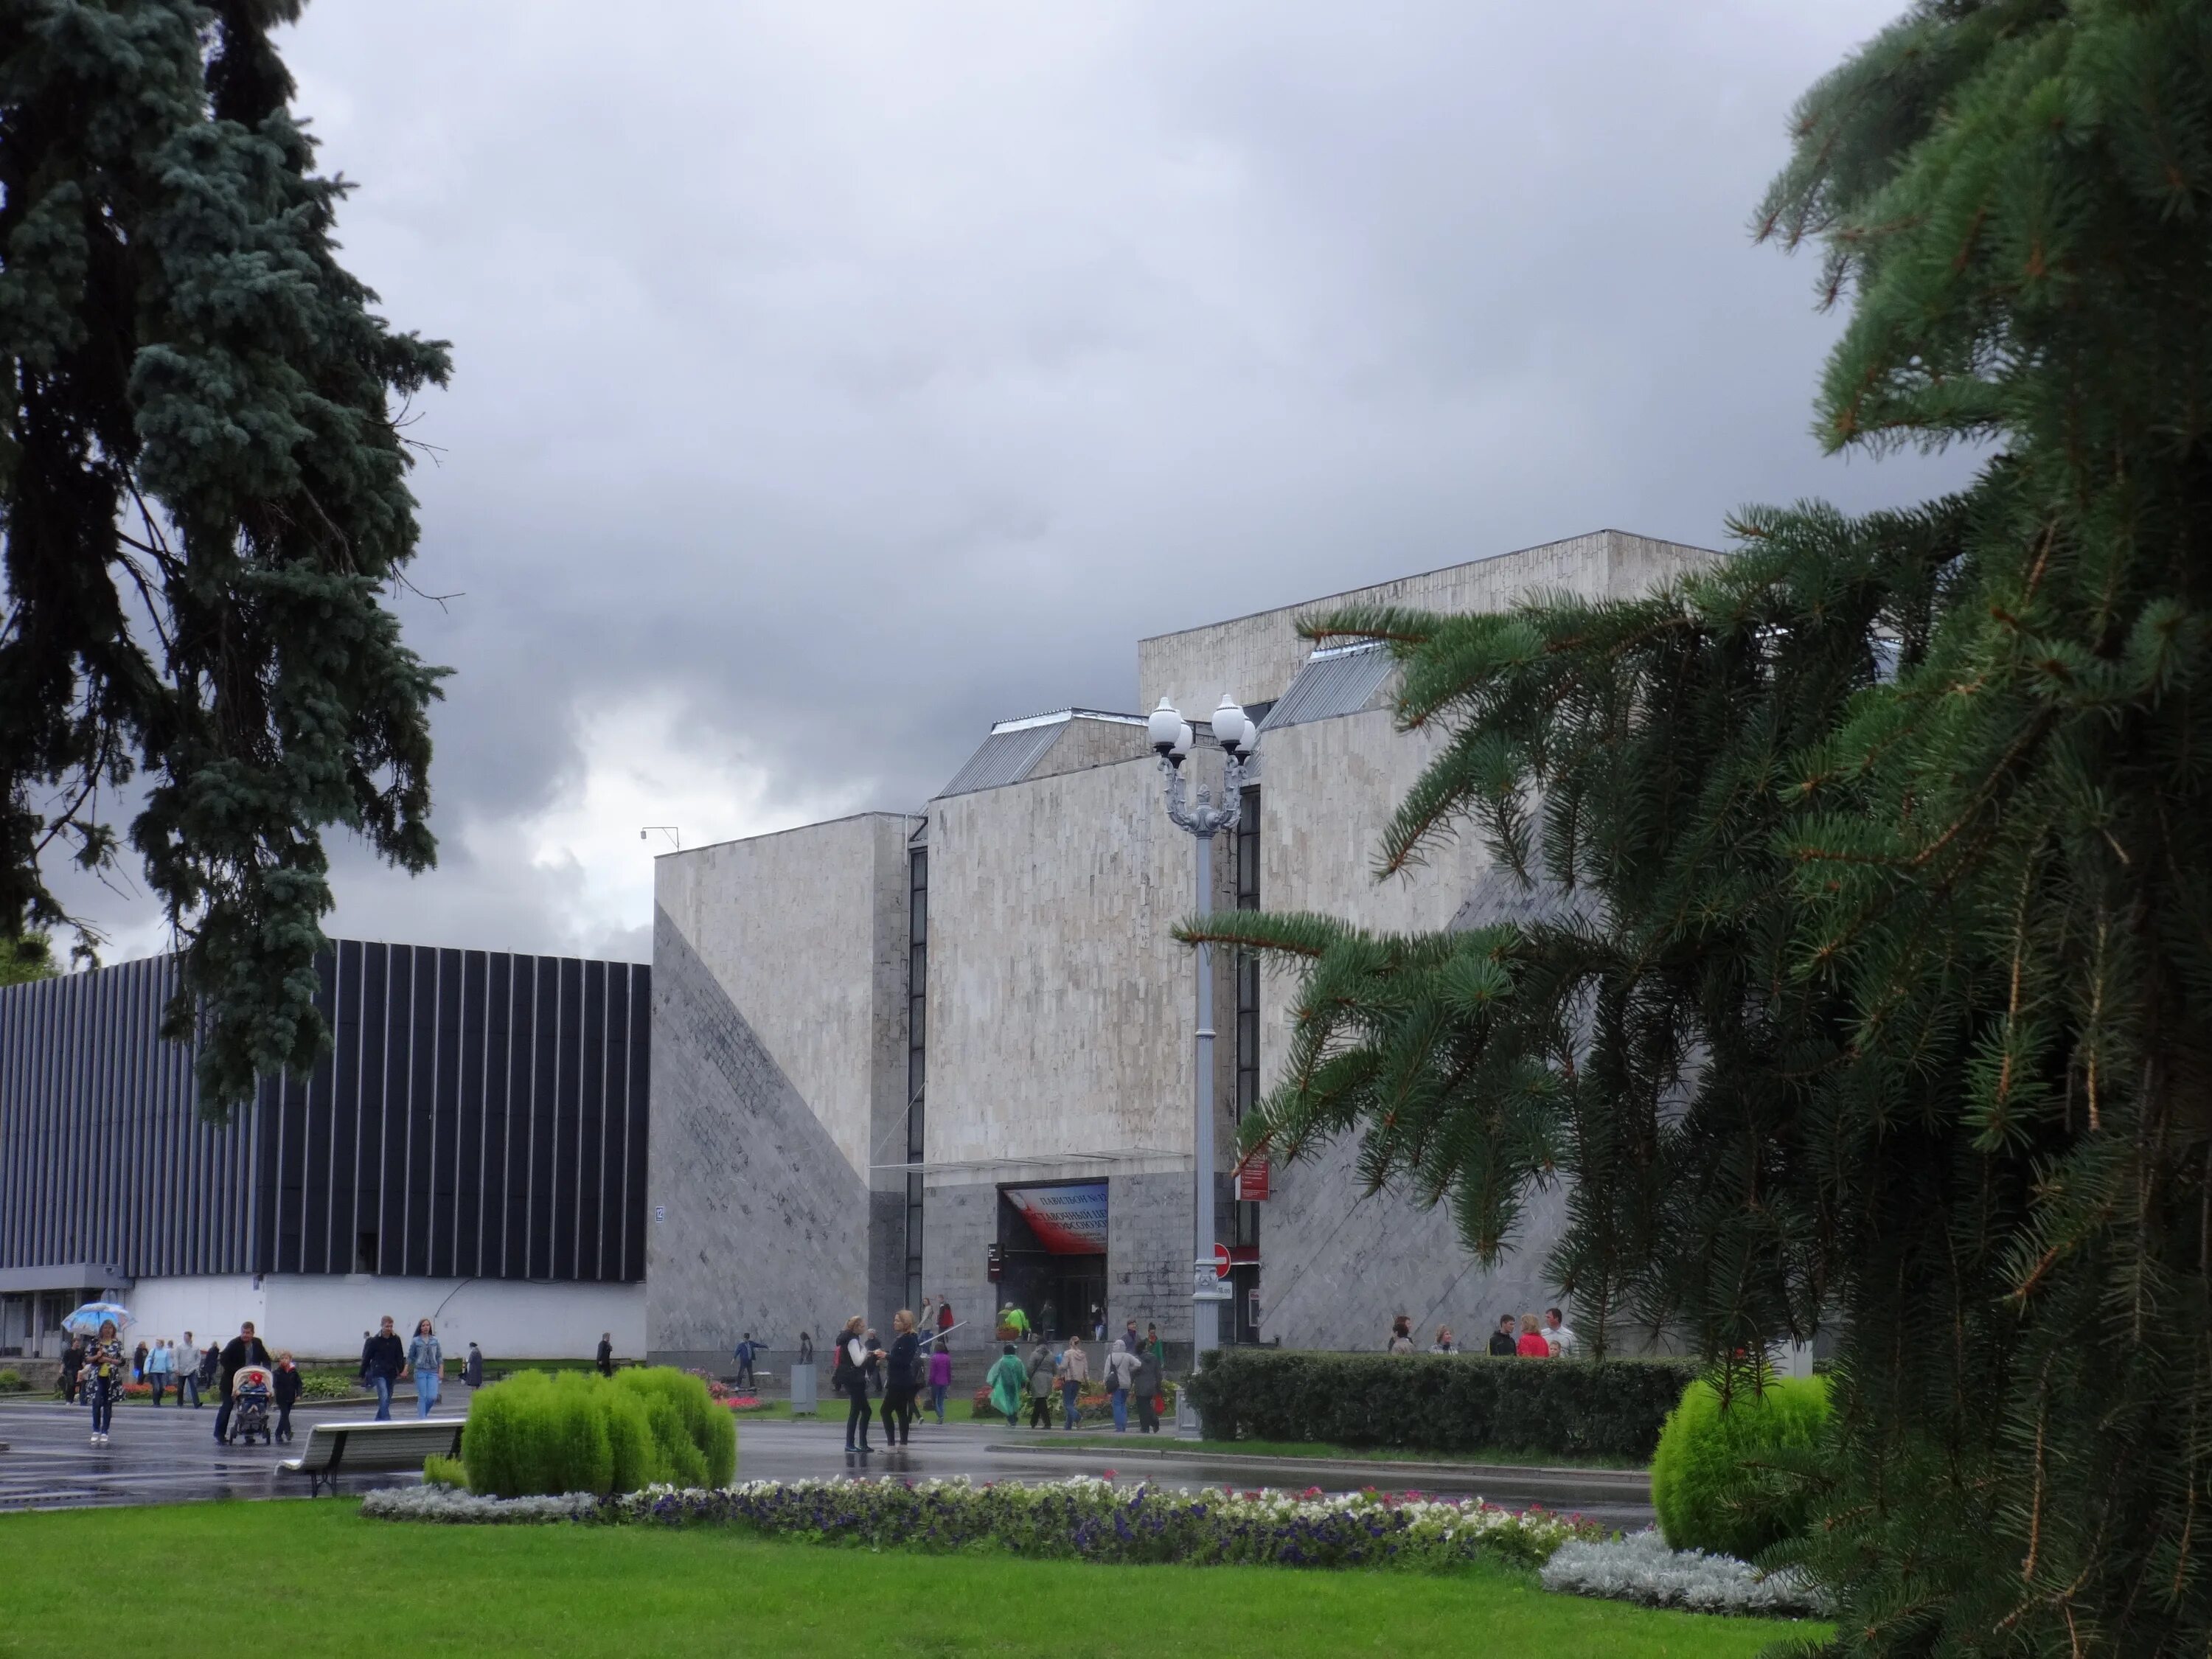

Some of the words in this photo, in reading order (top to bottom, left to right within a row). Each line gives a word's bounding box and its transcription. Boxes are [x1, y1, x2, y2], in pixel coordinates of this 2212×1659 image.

[1040, 1194, 1088, 1205] ПАВИЛЬОН
[656, 1208, 663, 1217] 12
[1031, 1209, 1091, 1220] СТАВОЧНЫЙ
